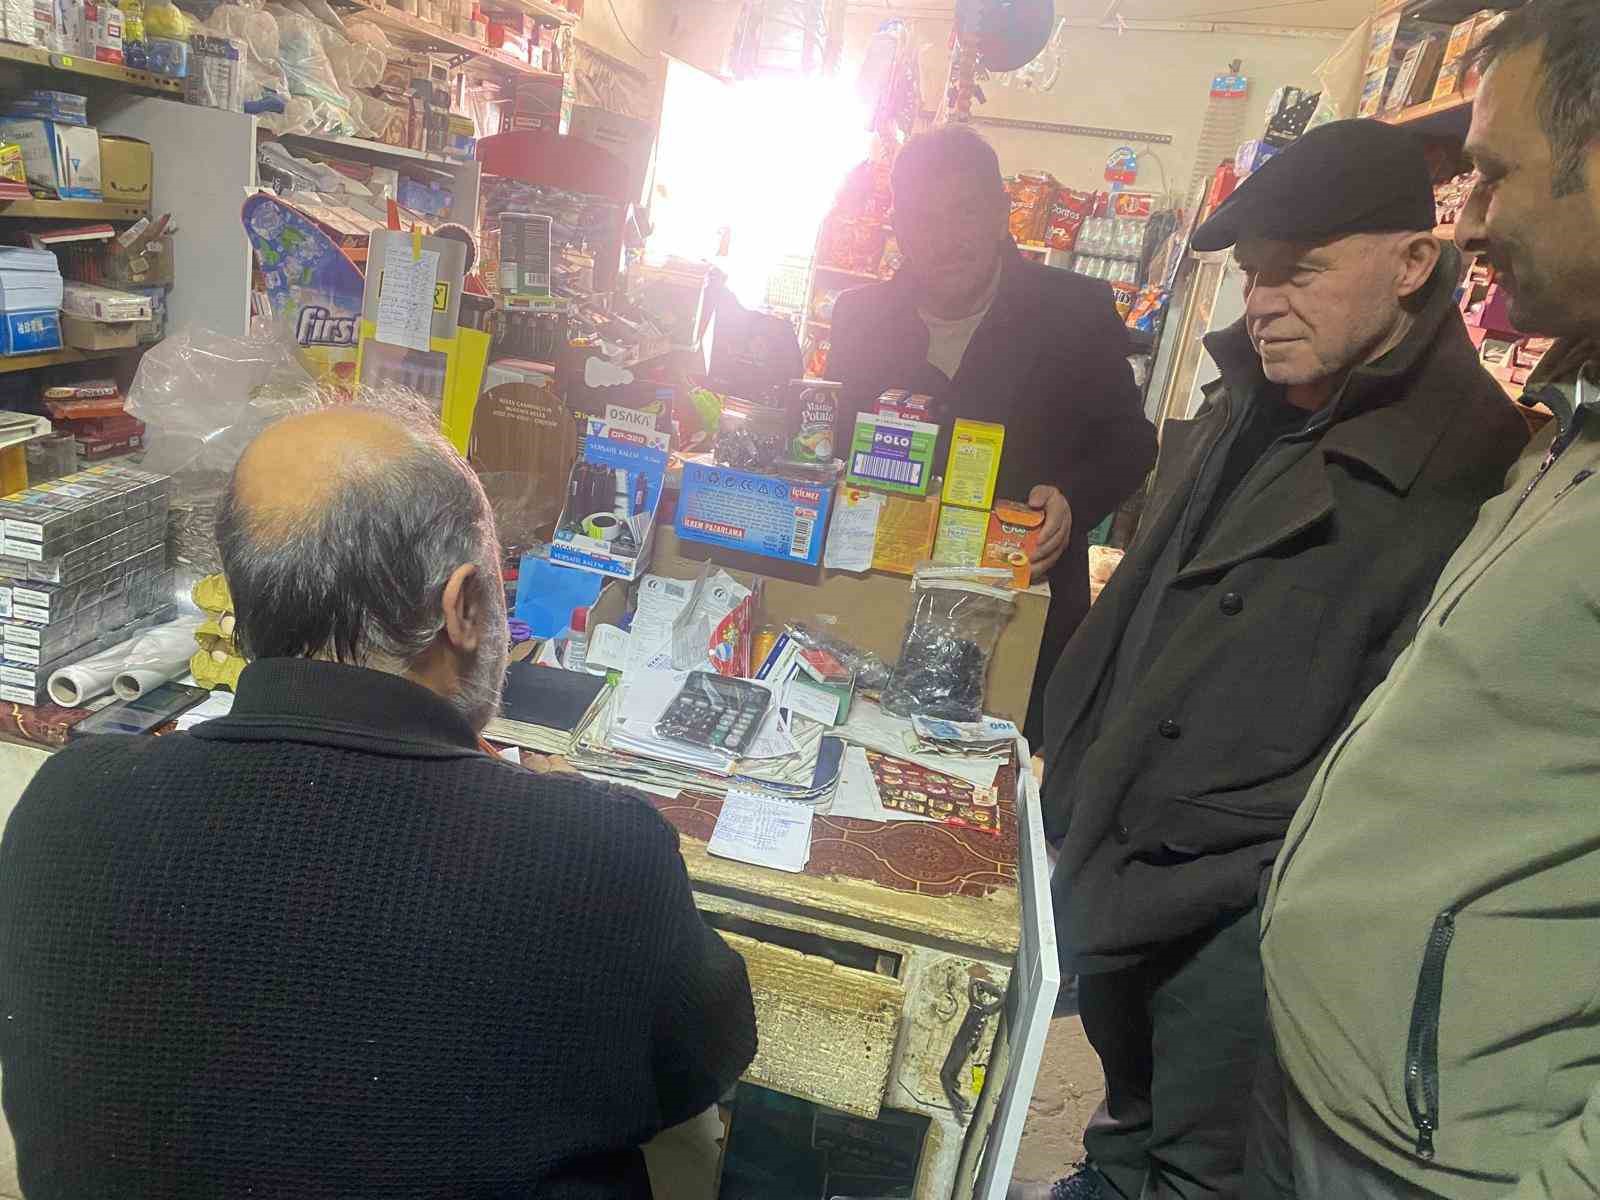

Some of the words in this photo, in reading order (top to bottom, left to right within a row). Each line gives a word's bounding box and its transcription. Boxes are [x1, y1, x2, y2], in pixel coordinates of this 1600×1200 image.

[1051, 203, 1081, 220] Doritos
[609, 408, 651, 428] OSAKA
[874, 433, 910, 447] POLO
